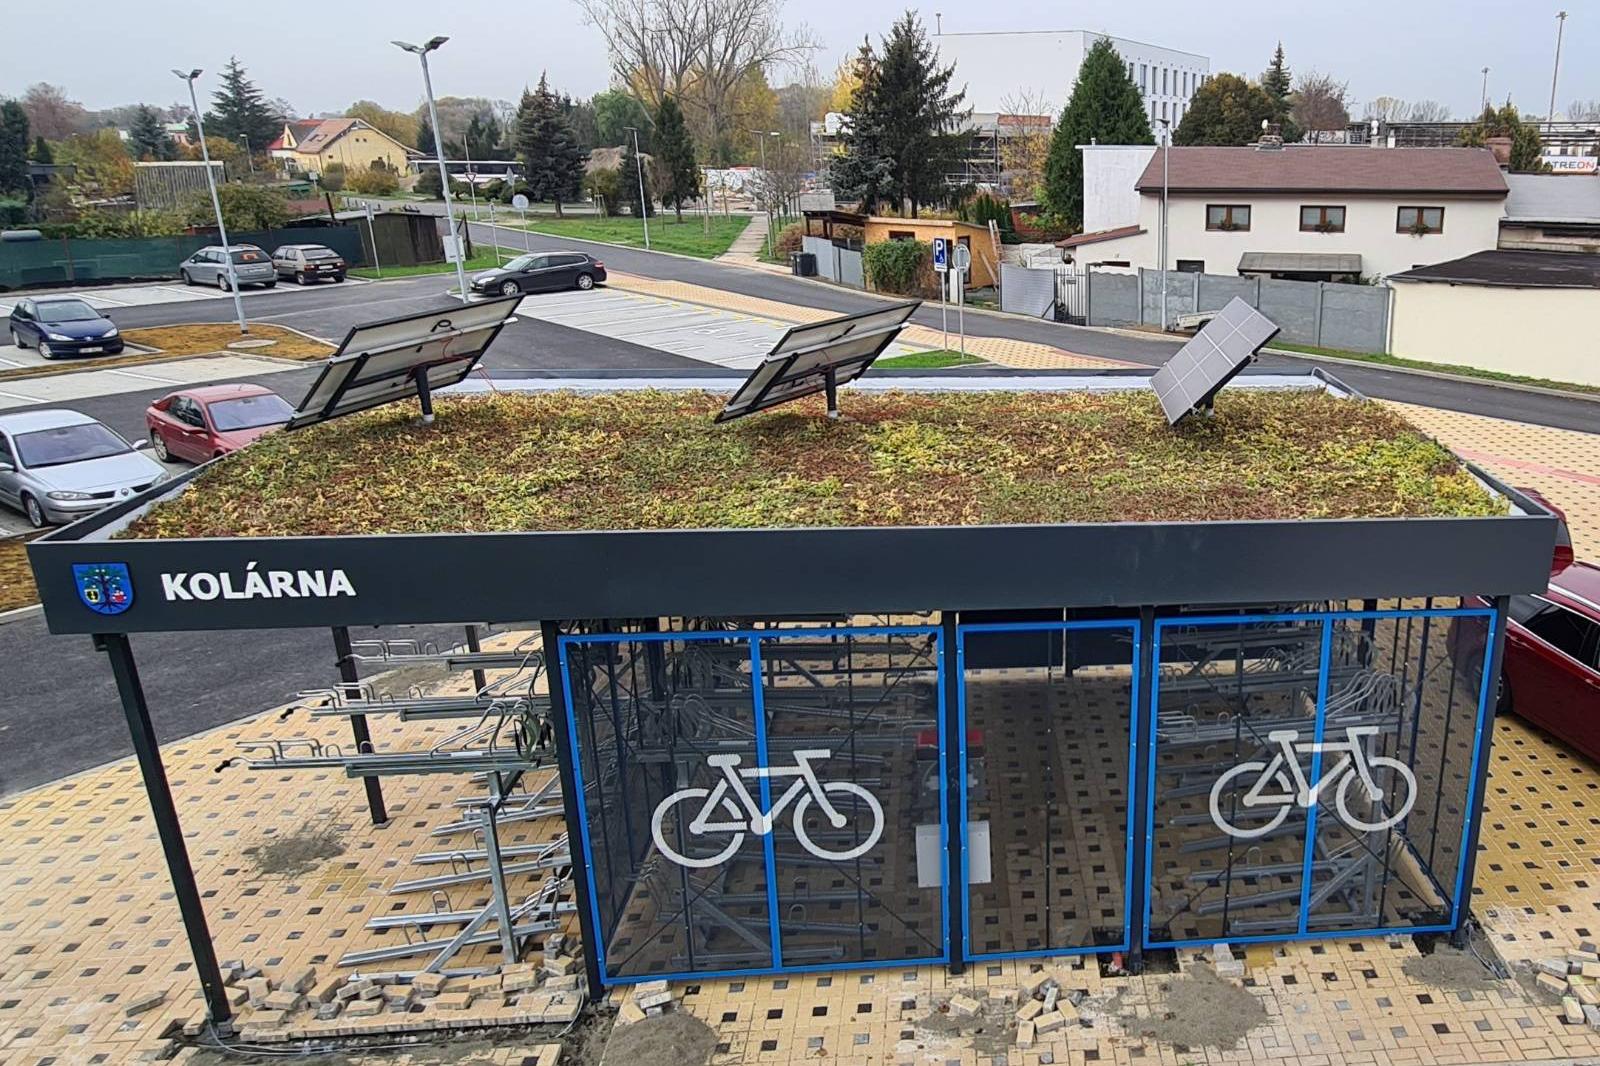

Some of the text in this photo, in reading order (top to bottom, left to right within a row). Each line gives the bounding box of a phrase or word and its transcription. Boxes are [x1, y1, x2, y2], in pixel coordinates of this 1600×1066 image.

[1550, 160, 1595, 169] TREON
[935, 239, 944, 256] P
[160, 561, 357, 601] KOLÁRNA
